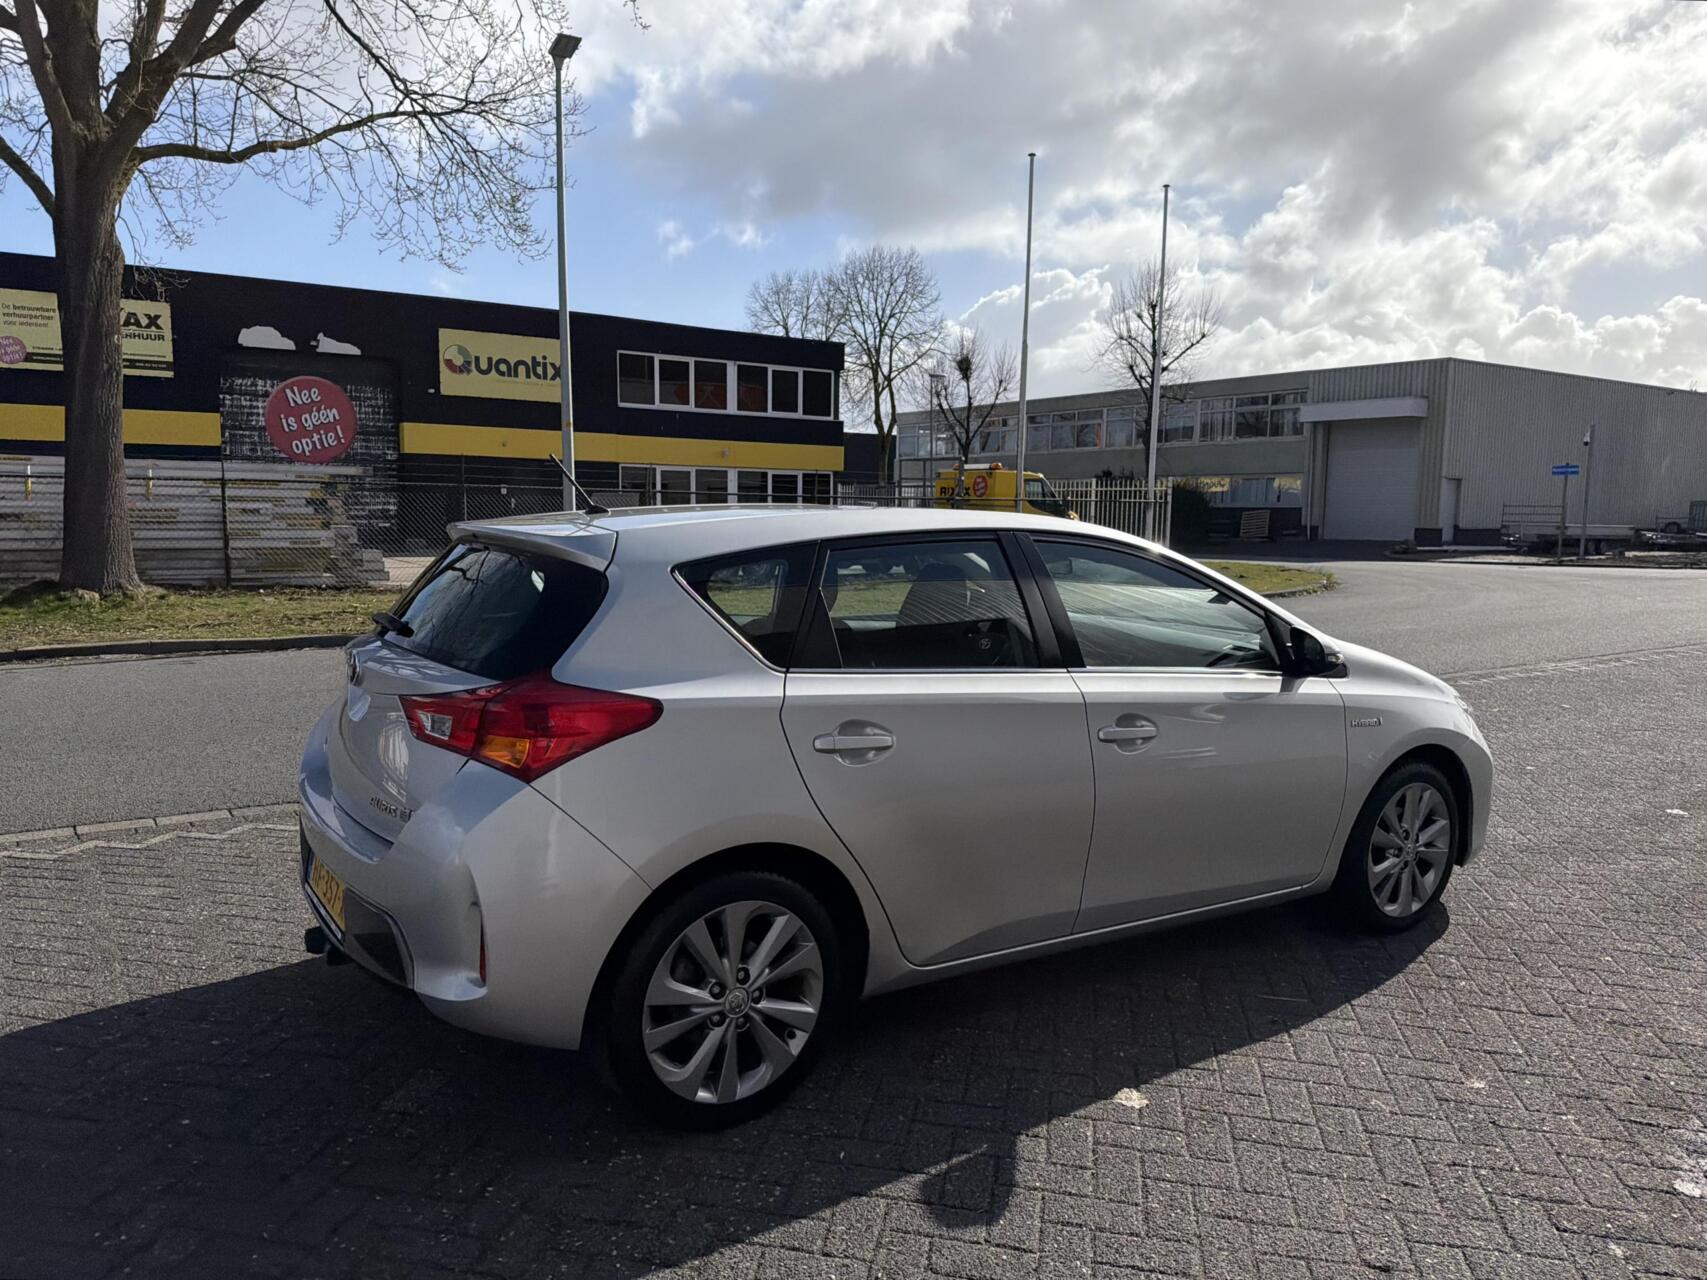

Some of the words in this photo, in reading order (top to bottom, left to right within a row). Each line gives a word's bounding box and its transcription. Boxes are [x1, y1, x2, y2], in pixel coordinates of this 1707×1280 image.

[119, 311, 164, 330] AX
[285, 386, 321, 407] Nee
[280, 413, 298, 432] is
[301, 404, 340, 431] géén
[292, 425, 345, 456] optie!
